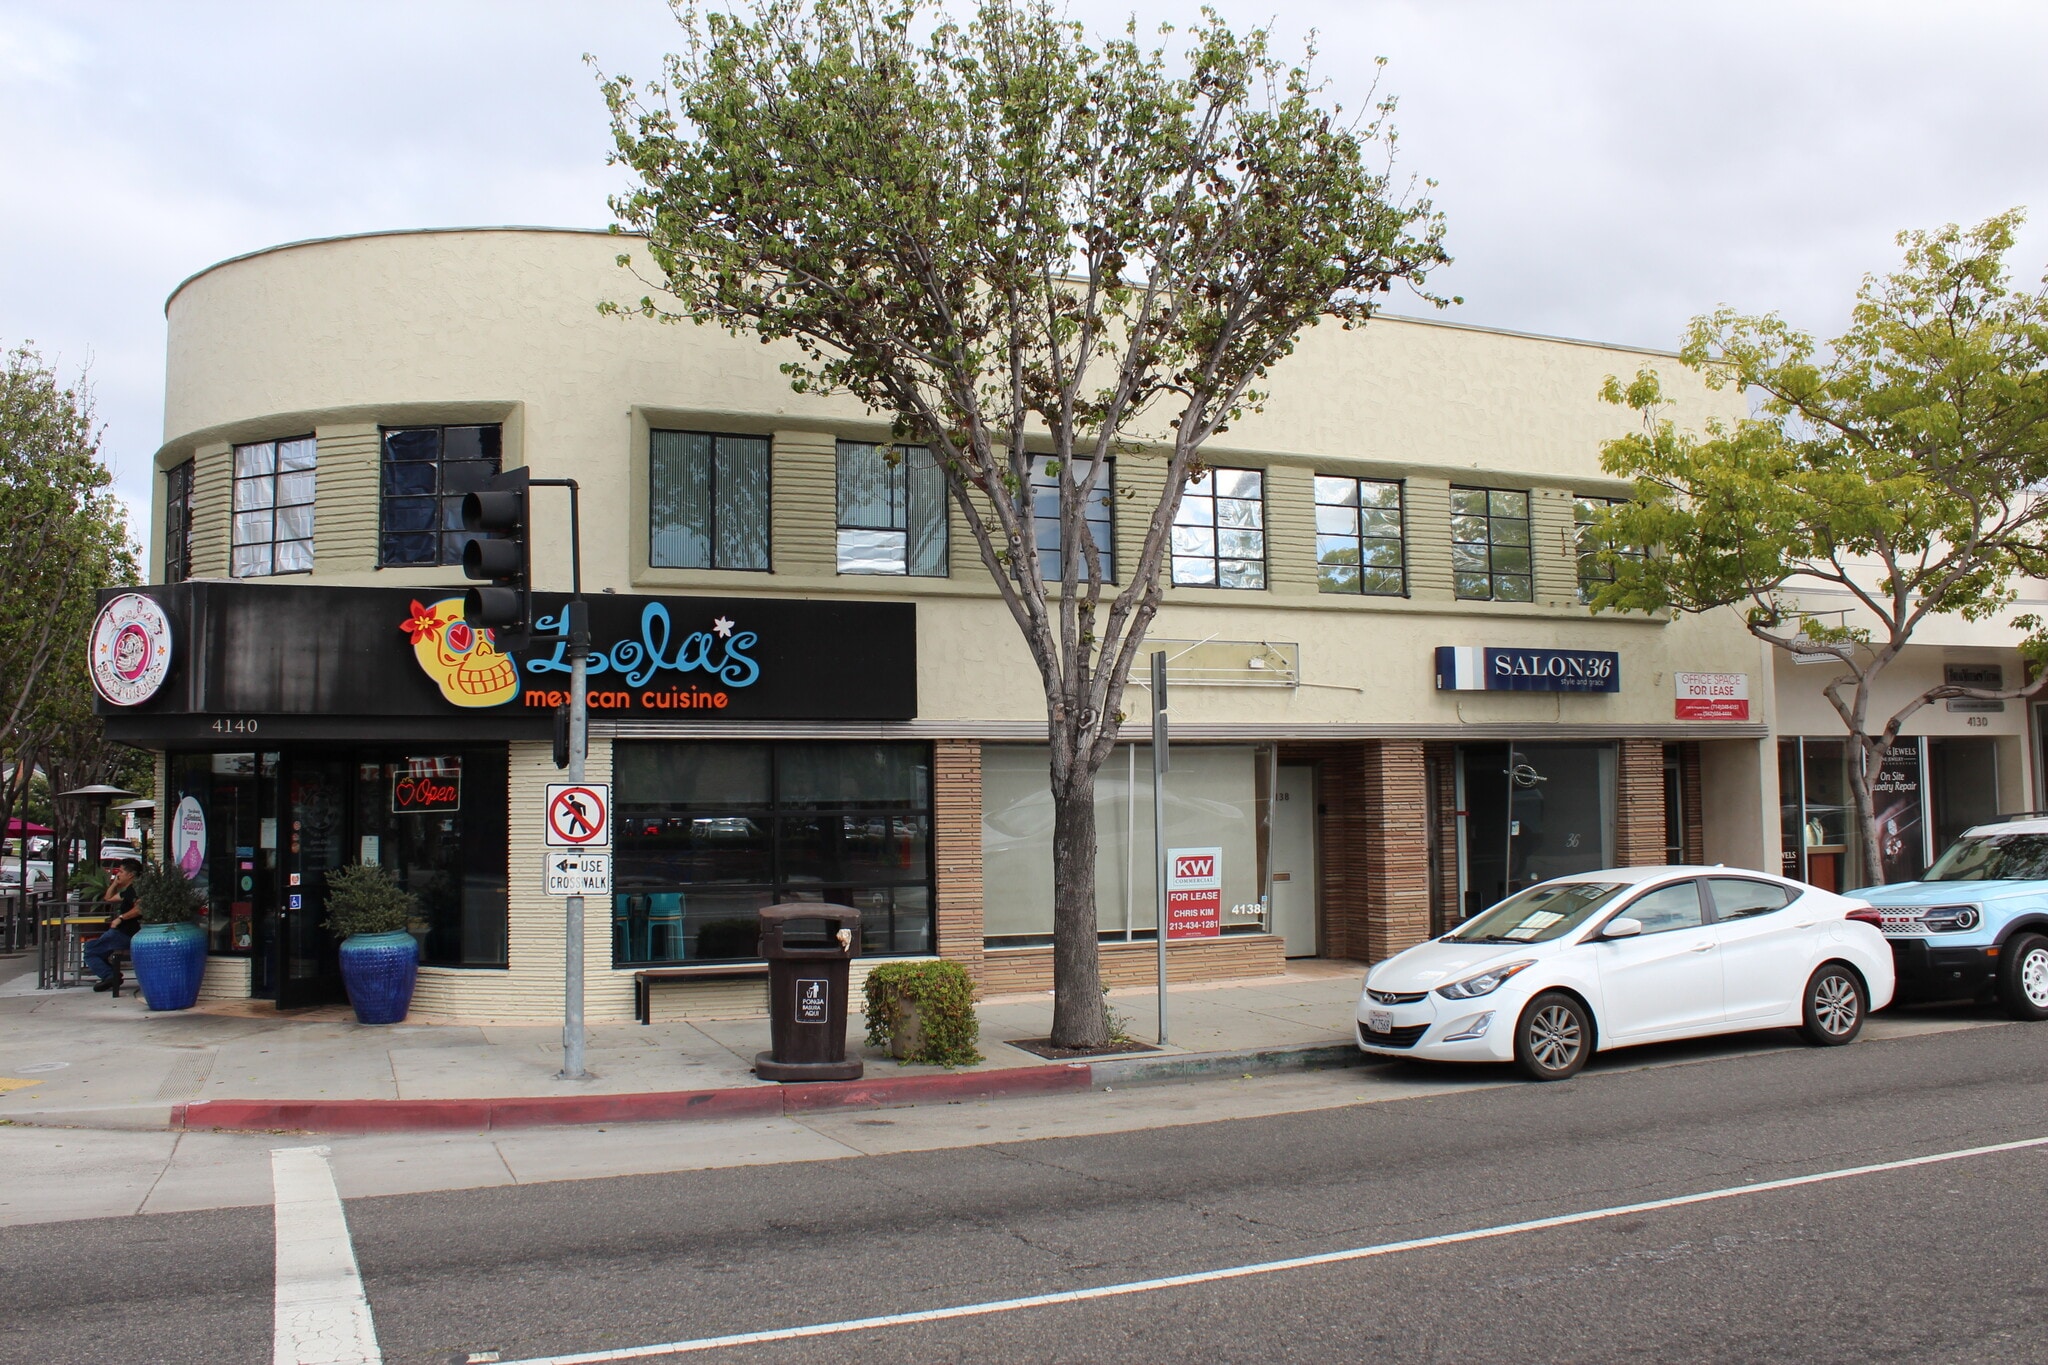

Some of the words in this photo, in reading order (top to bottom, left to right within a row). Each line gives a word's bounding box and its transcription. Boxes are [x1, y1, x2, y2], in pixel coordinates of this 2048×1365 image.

[526, 602, 760, 687] Lola's
[1495, 655, 1585, 677] SALON
[1586, 658, 1612, 678] 36
[1561, 678, 1575, 687] style
[1576, 678, 1588, 686] and
[1589, 679, 1604, 688] grace
[1682, 674, 1711, 684] OFFICE
[1714, 675, 1740, 685] SPACE
[1689, 686, 1707, 695] FOR
[1710, 686, 1734, 695] LEASE
[525, 690, 631, 708] mexcan
[641, 685, 729, 708] cuisine
[212, 719, 258, 733] 4140
[1967, 717, 1988, 727] 4130
[1892, 747, 1917, 756] JEWELS
[1880, 772, 1891, 781] On
[1892, 772, 1905, 781] Site
[416, 779, 457, 806] Open
[1873, 782, 1894, 793] welry
[1895, 782, 1917, 792] Repair
[1566, 833, 1581, 847] 36
[581, 860, 603, 873] USE
[1177, 860, 1212, 876] KW
[550, 876, 606, 889] CROSSWALK
[1191, 892, 1218, 900] LEASE
[1232, 904, 1261, 914] 4138
[1169, 921, 1218, 930] 213-434-1281
